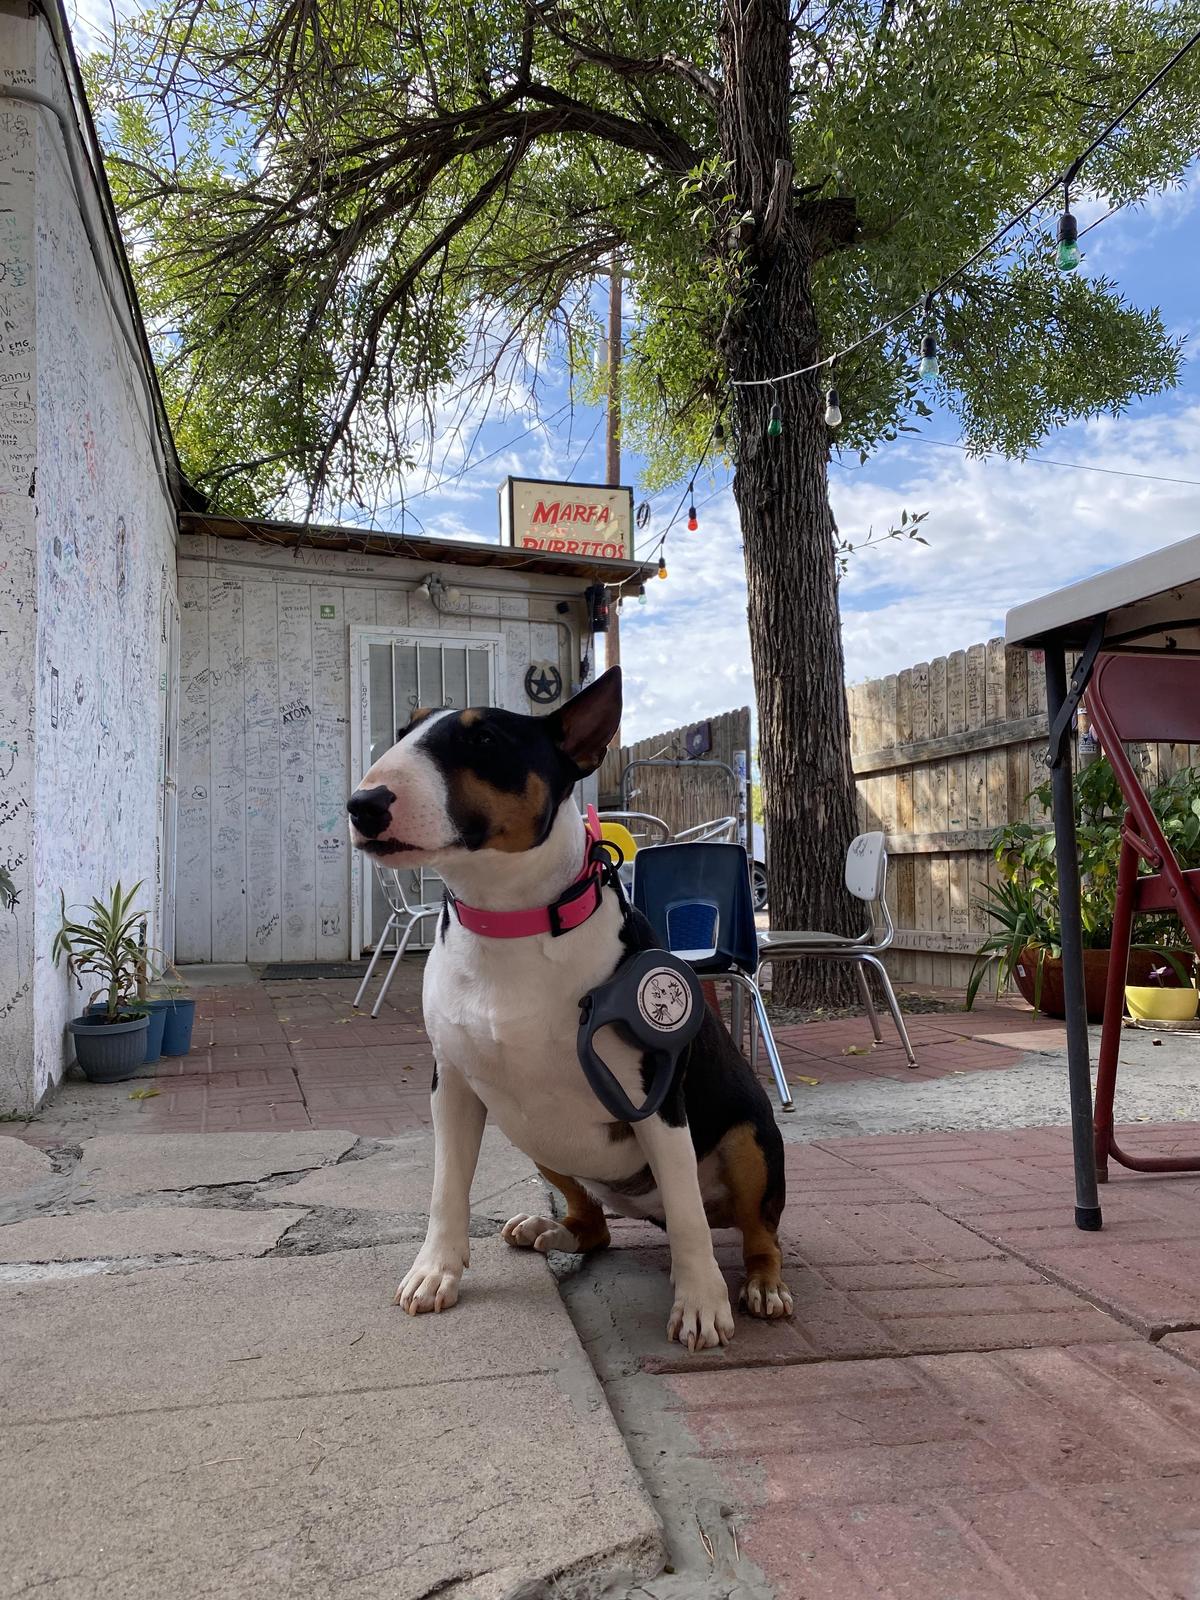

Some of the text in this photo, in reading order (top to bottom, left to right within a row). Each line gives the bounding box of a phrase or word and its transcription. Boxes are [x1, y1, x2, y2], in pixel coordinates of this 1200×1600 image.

[9, 339, 29, 350] EMG
[532, 501, 610, 525] MARFA
[282, 705, 312, 725] ATOM
